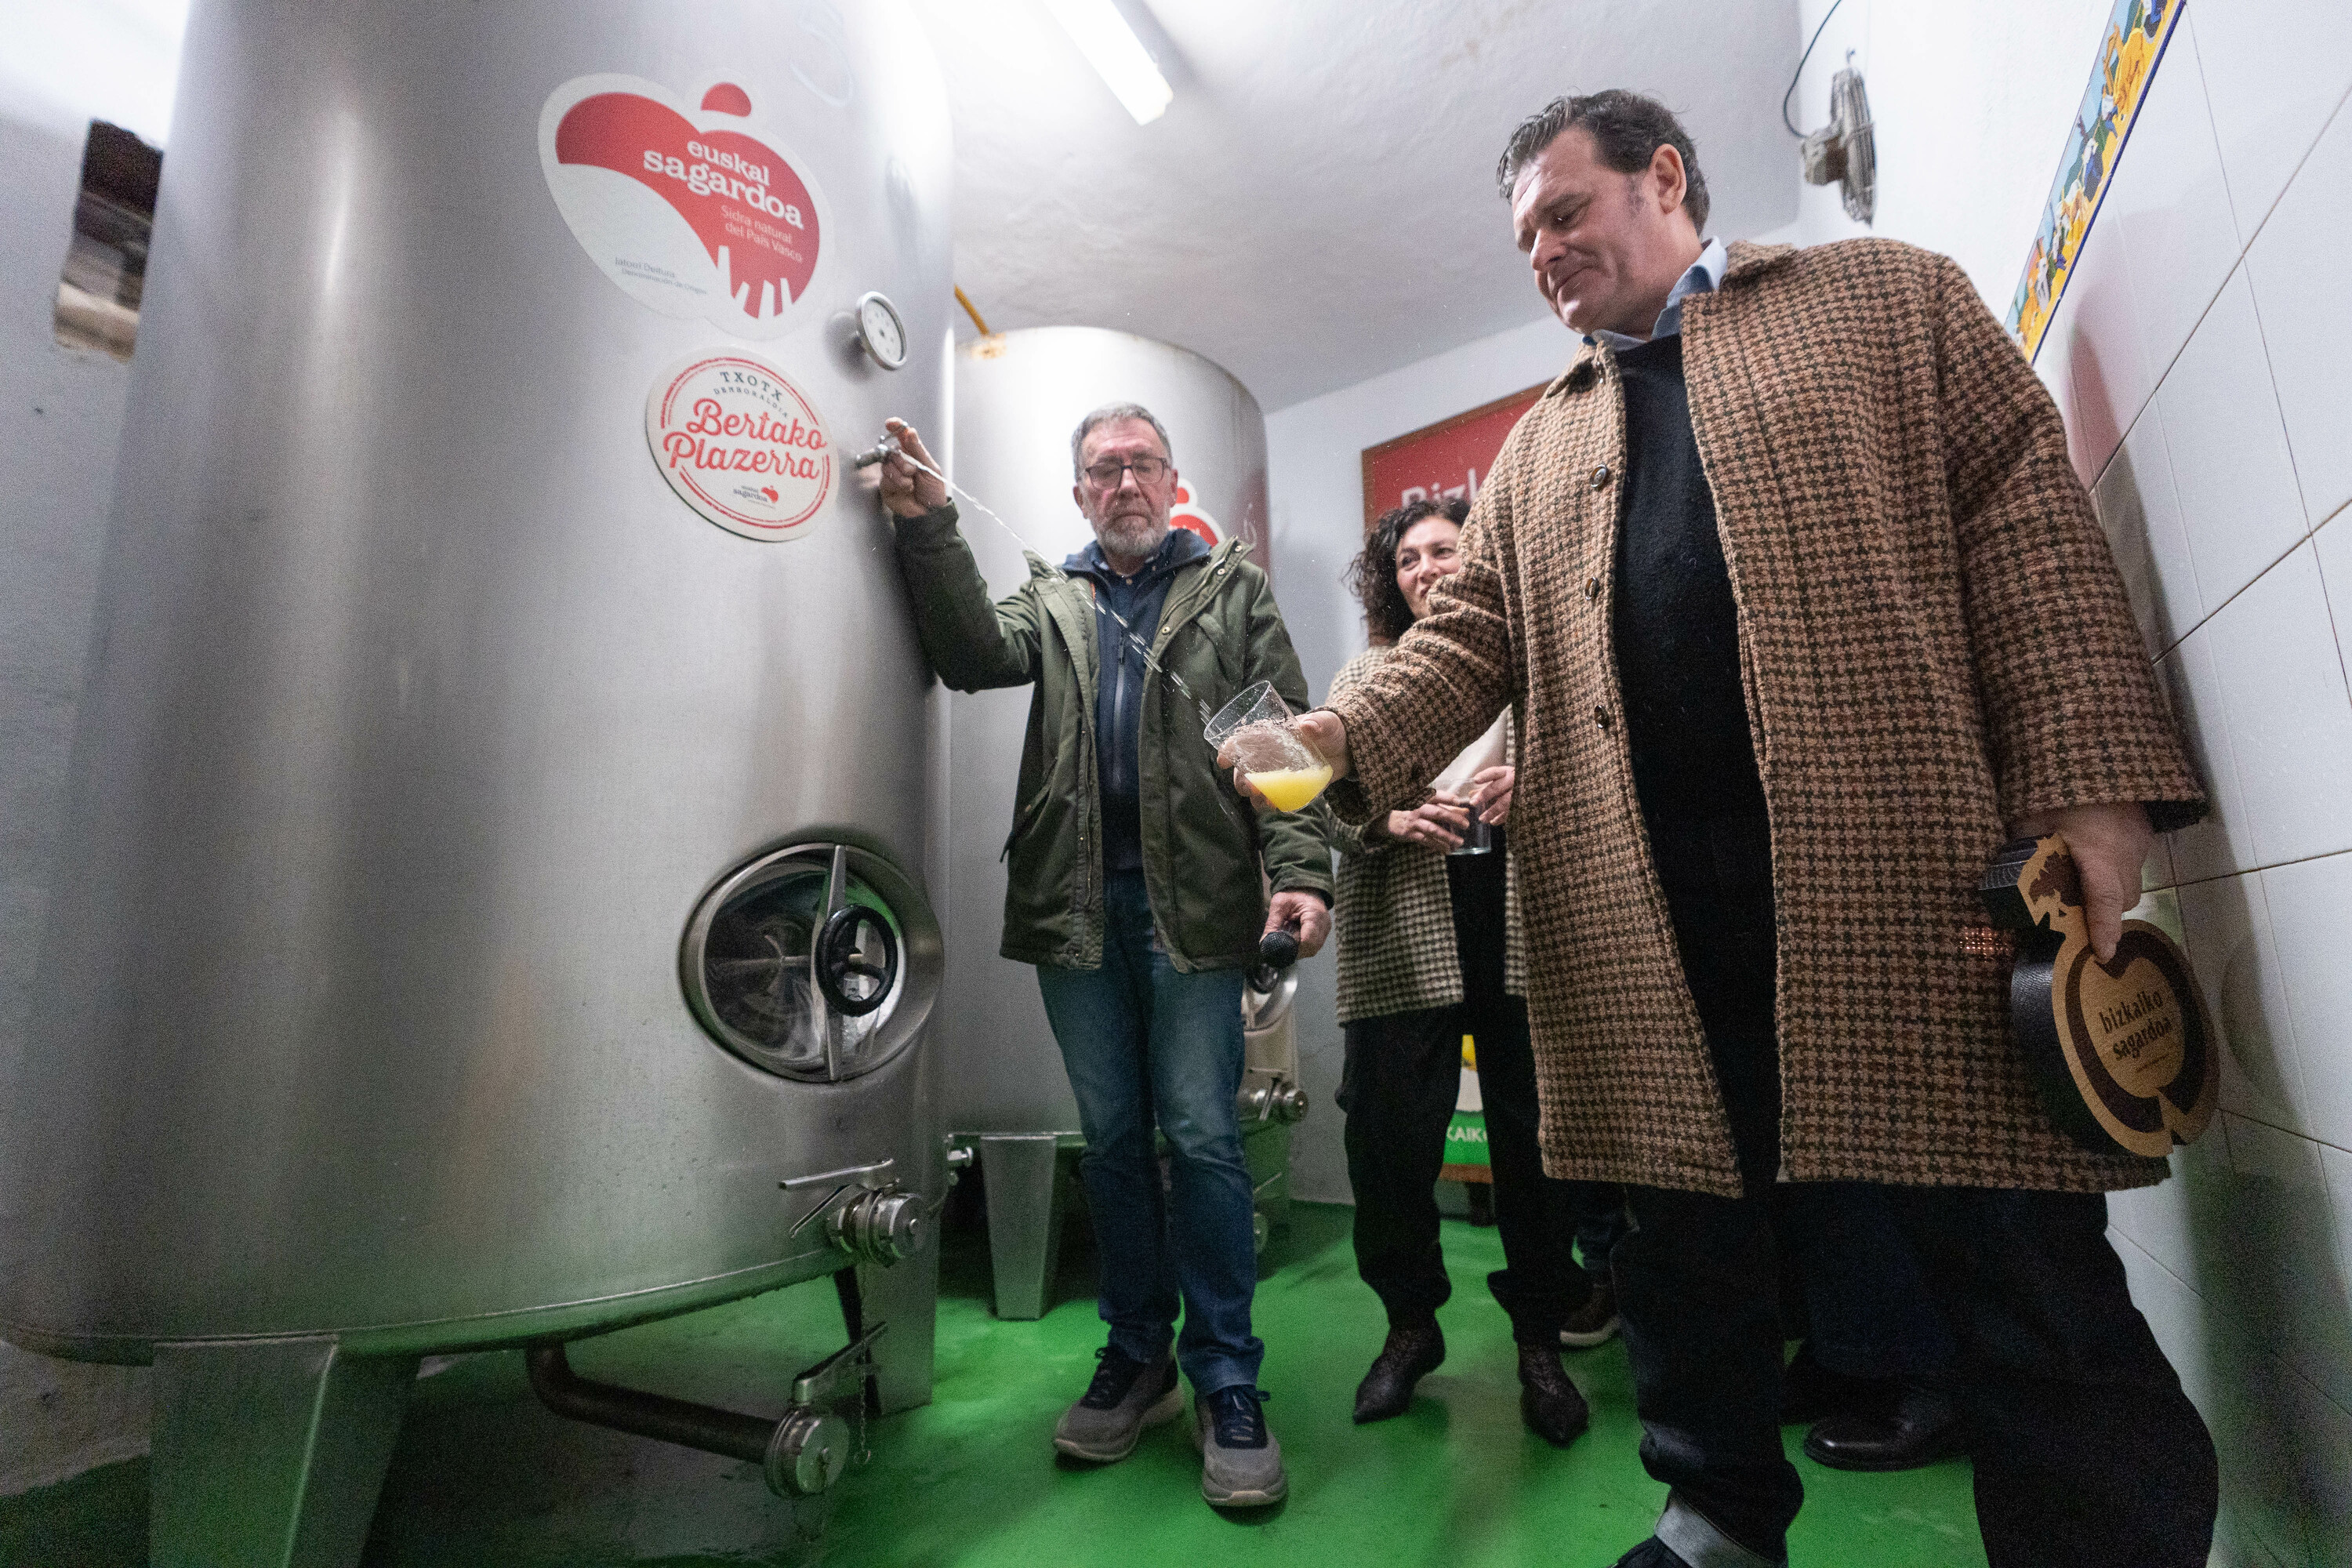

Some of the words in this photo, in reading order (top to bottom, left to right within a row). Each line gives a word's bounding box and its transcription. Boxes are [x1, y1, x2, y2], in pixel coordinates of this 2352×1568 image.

[687, 140, 770, 187] euskal
[644, 149, 804, 230] sagardoa
[720, 205, 753, 227] Sidra
[754, 220, 792, 245] natural
[725, 222, 744, 237] del
[746, 229, 770, 249] País
[771, 239, 803, 264] Vasco
[719, 372, 782, 401] TXOTX
[686, 397, 828, 450] Bertako
[662, 431, 820, 480] Plazerra
[2099, 990, 2164, 1034] bizkaiko
[2112, 1017, 2172, 1061] sagardoa
